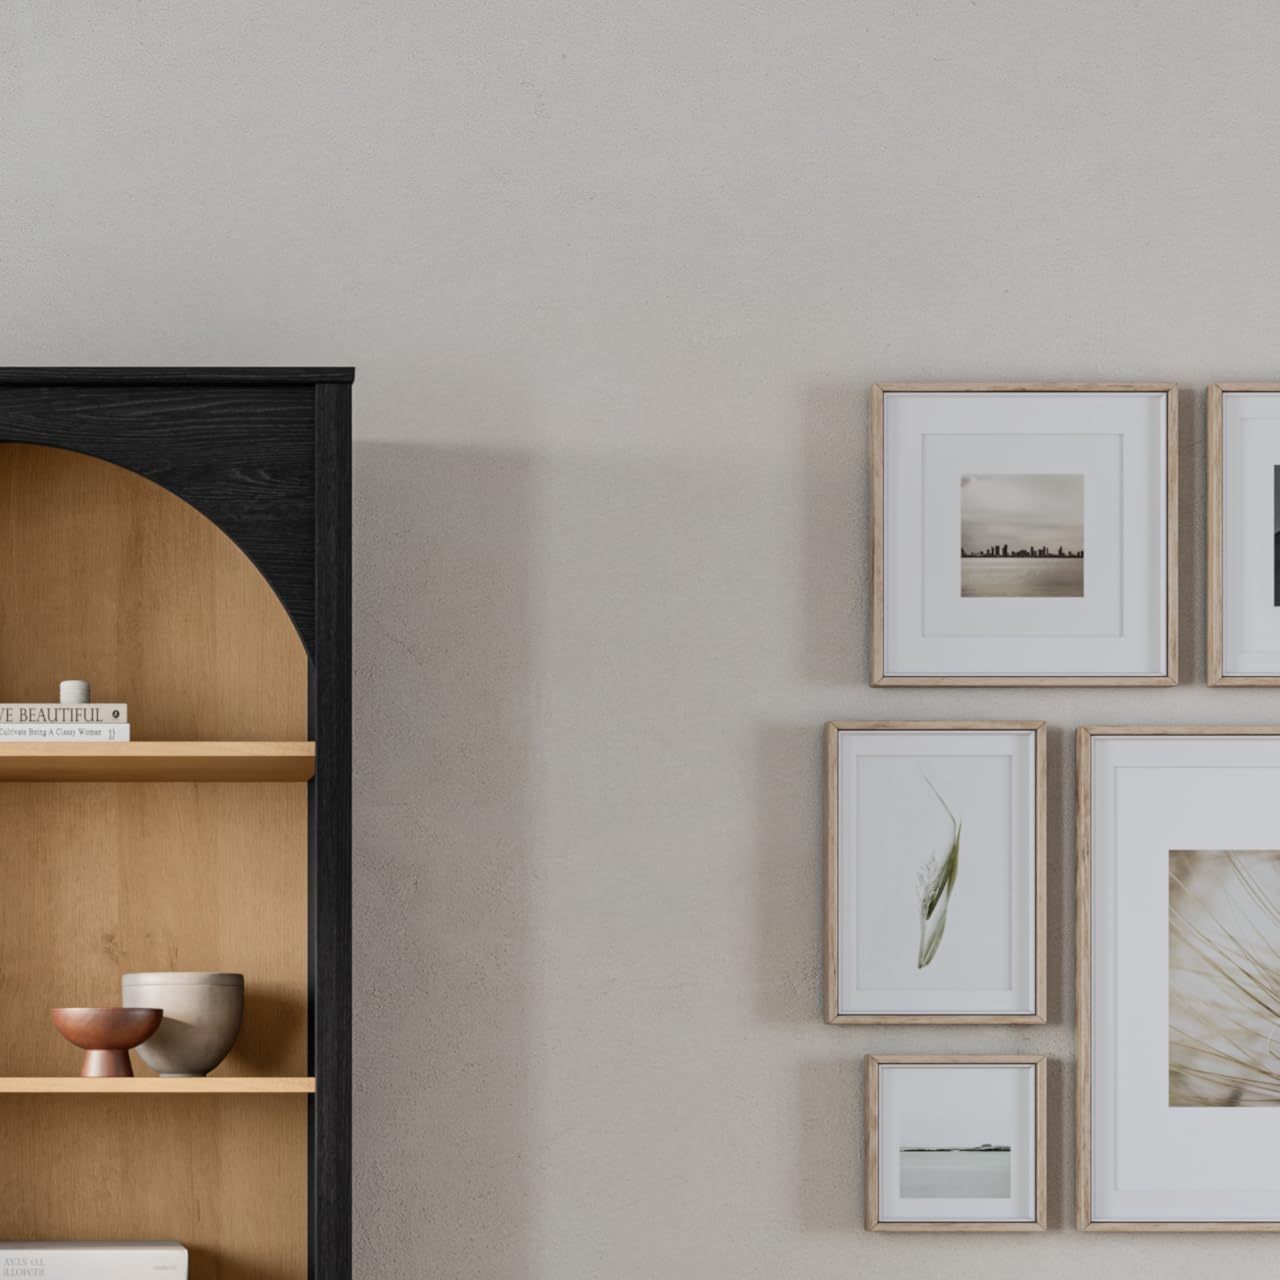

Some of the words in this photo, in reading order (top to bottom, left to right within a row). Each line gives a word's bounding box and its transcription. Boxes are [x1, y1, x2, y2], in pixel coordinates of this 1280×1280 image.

[19, 707, 103, 722] BEAUTIFUL
[28, 728, 47, 737] Being
[48, 728, 54, 736] A
